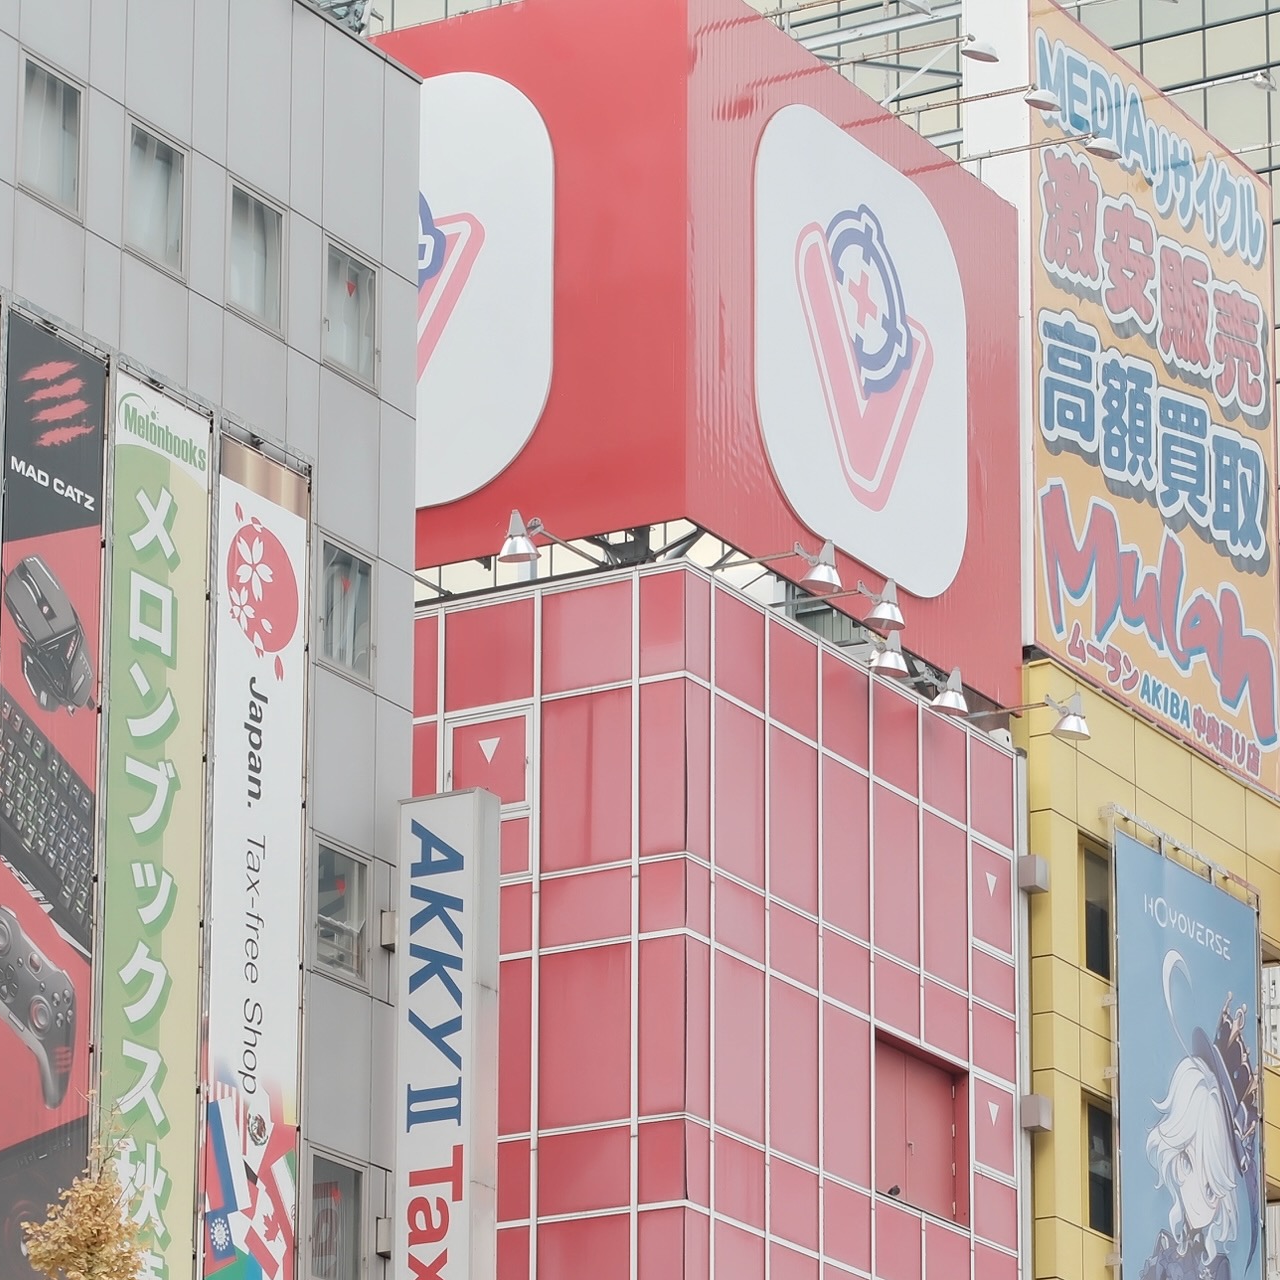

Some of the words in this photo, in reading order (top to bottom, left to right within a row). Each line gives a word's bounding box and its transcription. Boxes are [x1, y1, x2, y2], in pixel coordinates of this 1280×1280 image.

[1038, 142, 1268, 408] 激安販売
[11, 456, 49, 489] MAD
[52, 480, 96, 512] CATZ
[124, 405, 207, 473] Melonbooks
[1040, 312, 1268, 558] 高額買取
[1039, 480, 1279, 748] Mulan
[243, 676, 269, 808] Japan.
[242, 834, 266, 985] Tax-free
[408, 818, 464, 1071] AKKY
[1143, 893, 1232, 961] HOYOVERSE
[237, 998, 264, 1096] Shop
